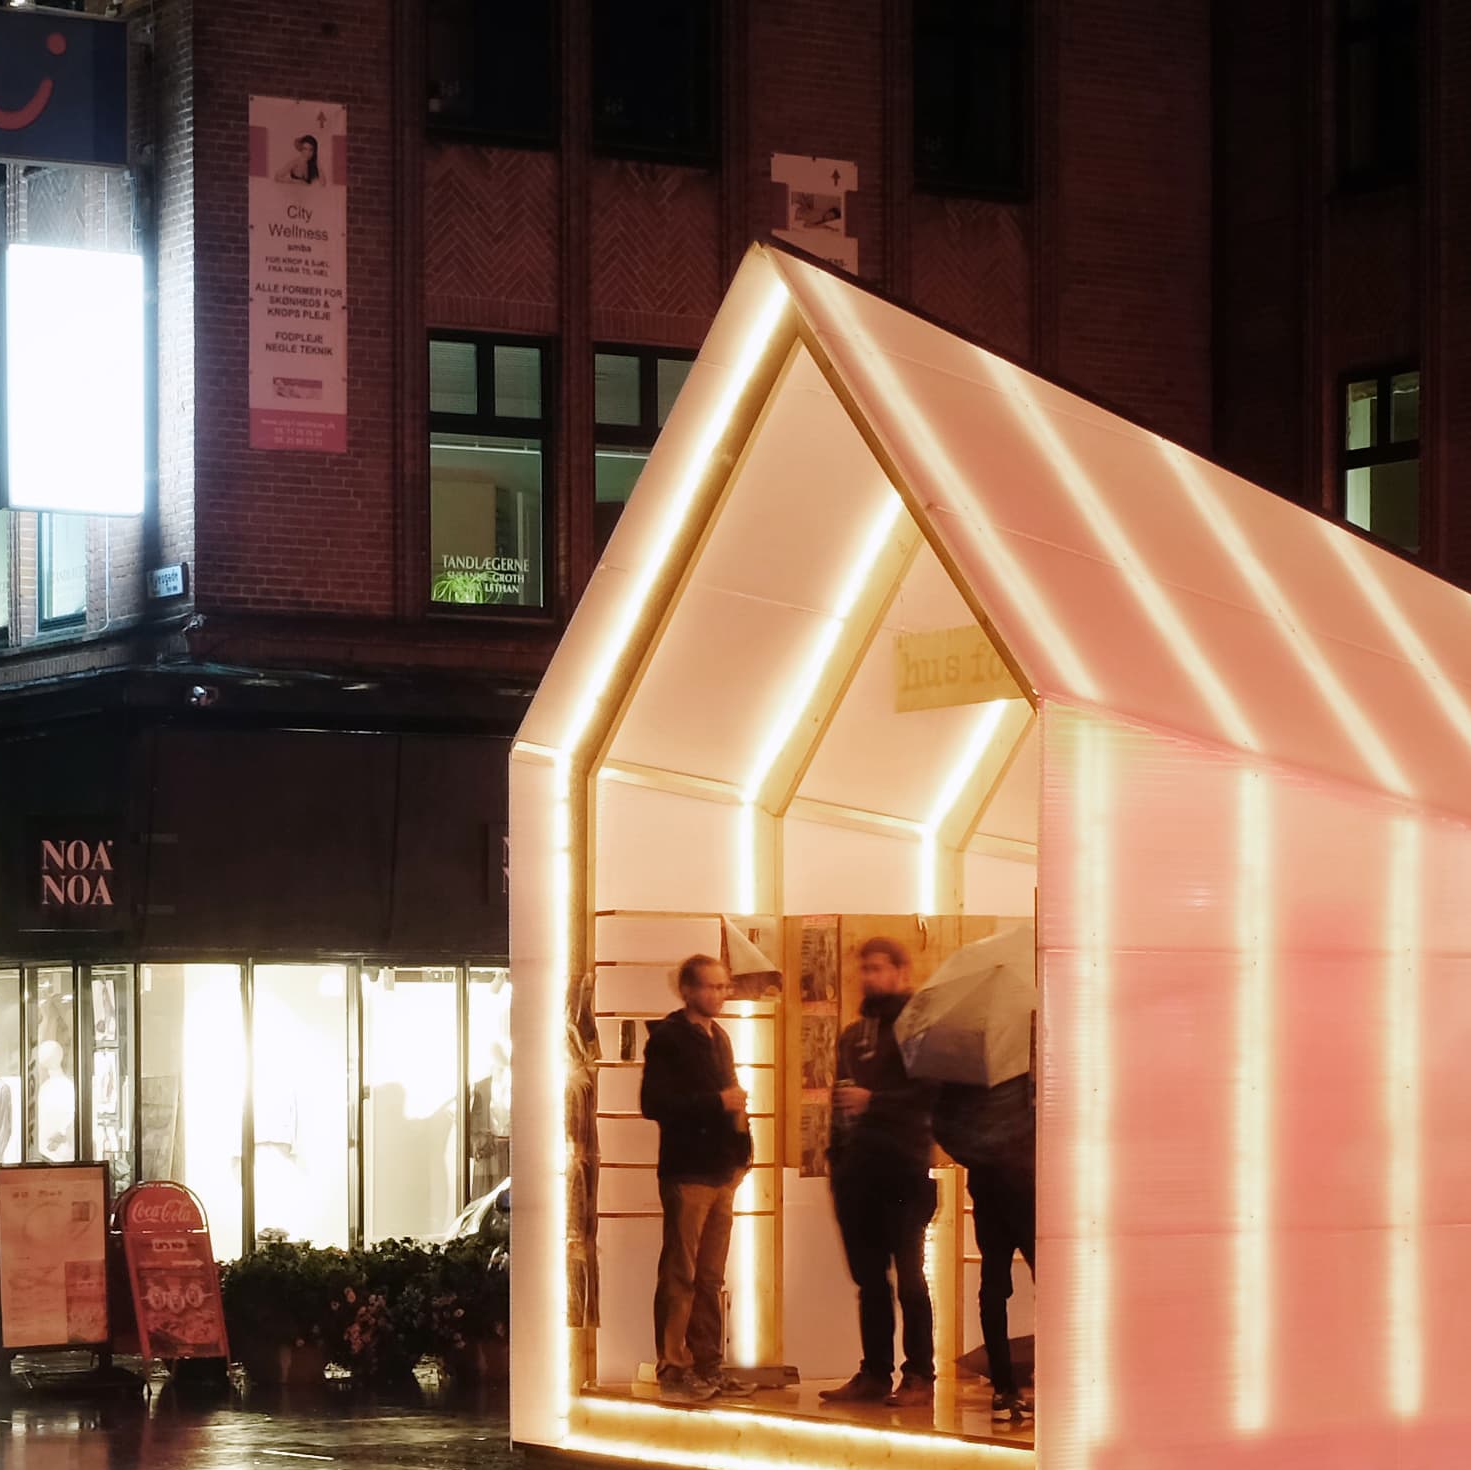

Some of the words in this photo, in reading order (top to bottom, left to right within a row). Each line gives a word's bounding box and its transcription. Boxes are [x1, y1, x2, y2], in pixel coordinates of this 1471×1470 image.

[287, 205, 313, 223] City
[268, 223, 329, 241] Wellness
[255, 282, 279, 293] ALLE
[282, 284, 322, 296] FORMER
[324, 288, 343, 298] FOR
[267, 308, 300, 318] KROPS
[302, 309, 331, 320] PLEJE
[299, 344, 333, 356] TEKNIK
[442, 554, 530, 572] TANDLÆGERNE
[492, 573, 525, 584] GROTH
[970, 641, 1004, 684] fo
[41, 840, 113, 870] NOA
[41, 874, 114, 905] NOA
